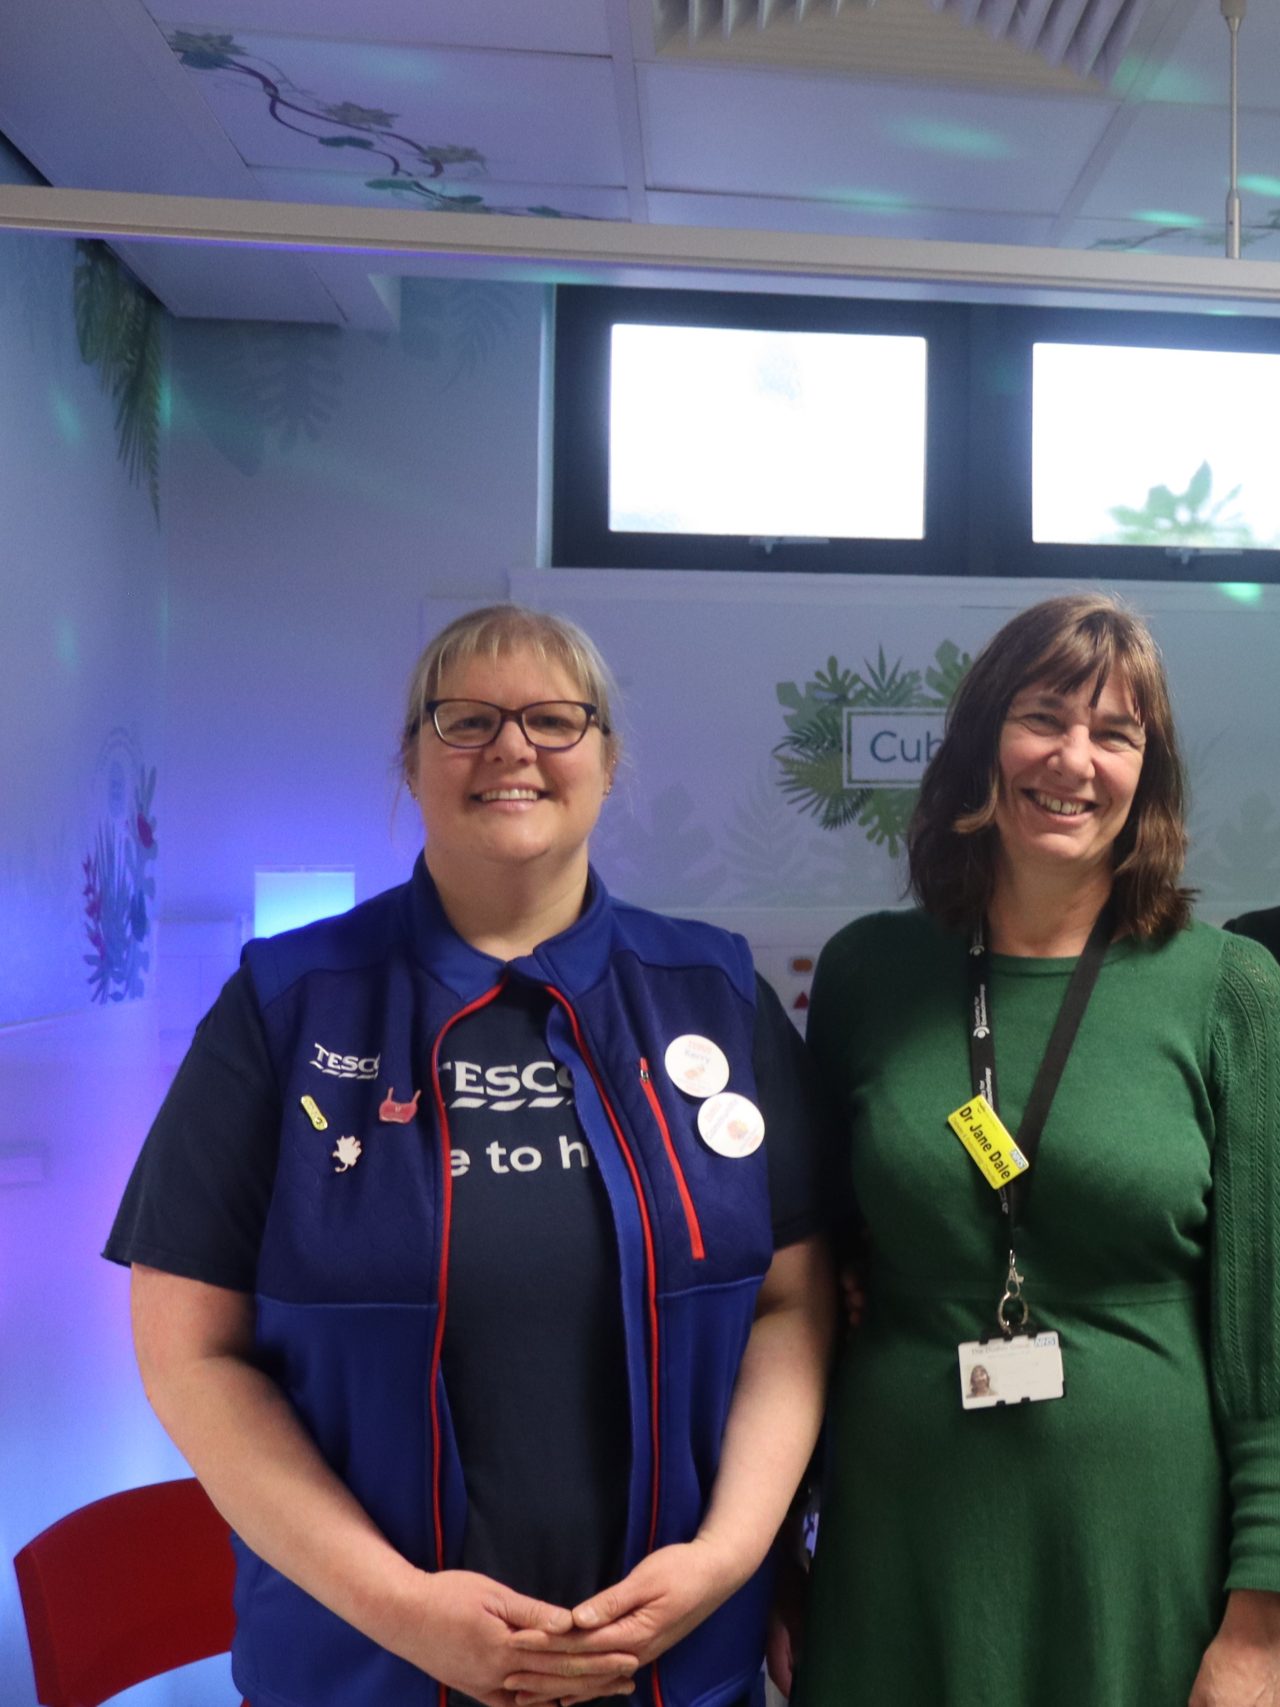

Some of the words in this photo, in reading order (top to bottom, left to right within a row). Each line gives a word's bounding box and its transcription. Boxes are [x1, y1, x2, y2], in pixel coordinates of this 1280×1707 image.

[486, 1140, 542, 1174] to
[960, 1106, 973, 1122] Dr
[970, 1124, 992, 1152] Jane
[989, 1151, 1011, 1180] Dale
